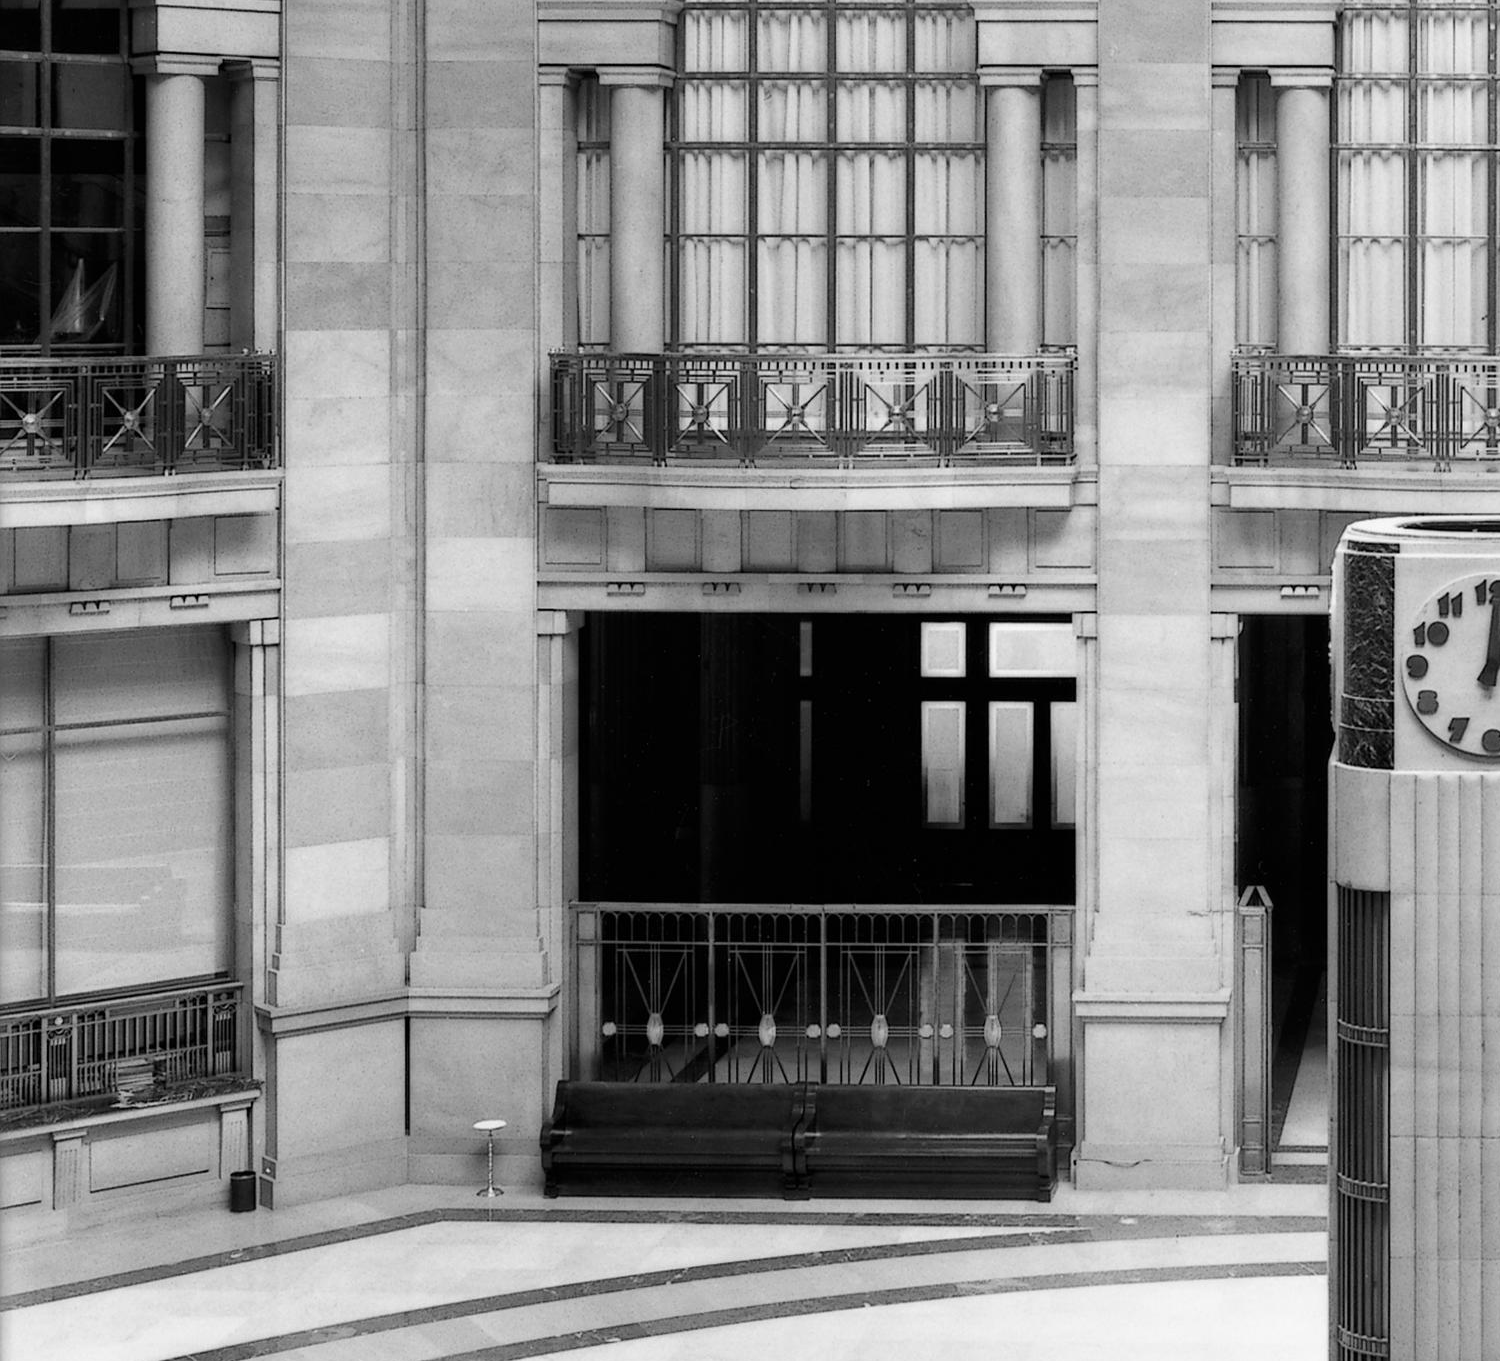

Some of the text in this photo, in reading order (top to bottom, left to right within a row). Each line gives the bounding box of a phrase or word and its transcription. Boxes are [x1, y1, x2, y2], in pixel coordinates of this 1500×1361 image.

[1437, 592, 1463, 618] 11
[1413, 621, 1449, 647] 10
[1406, 655, 1428, 679] 9
[1416, 690, 1439, 715] 8
[1448, 717, 1470, 744] 7
